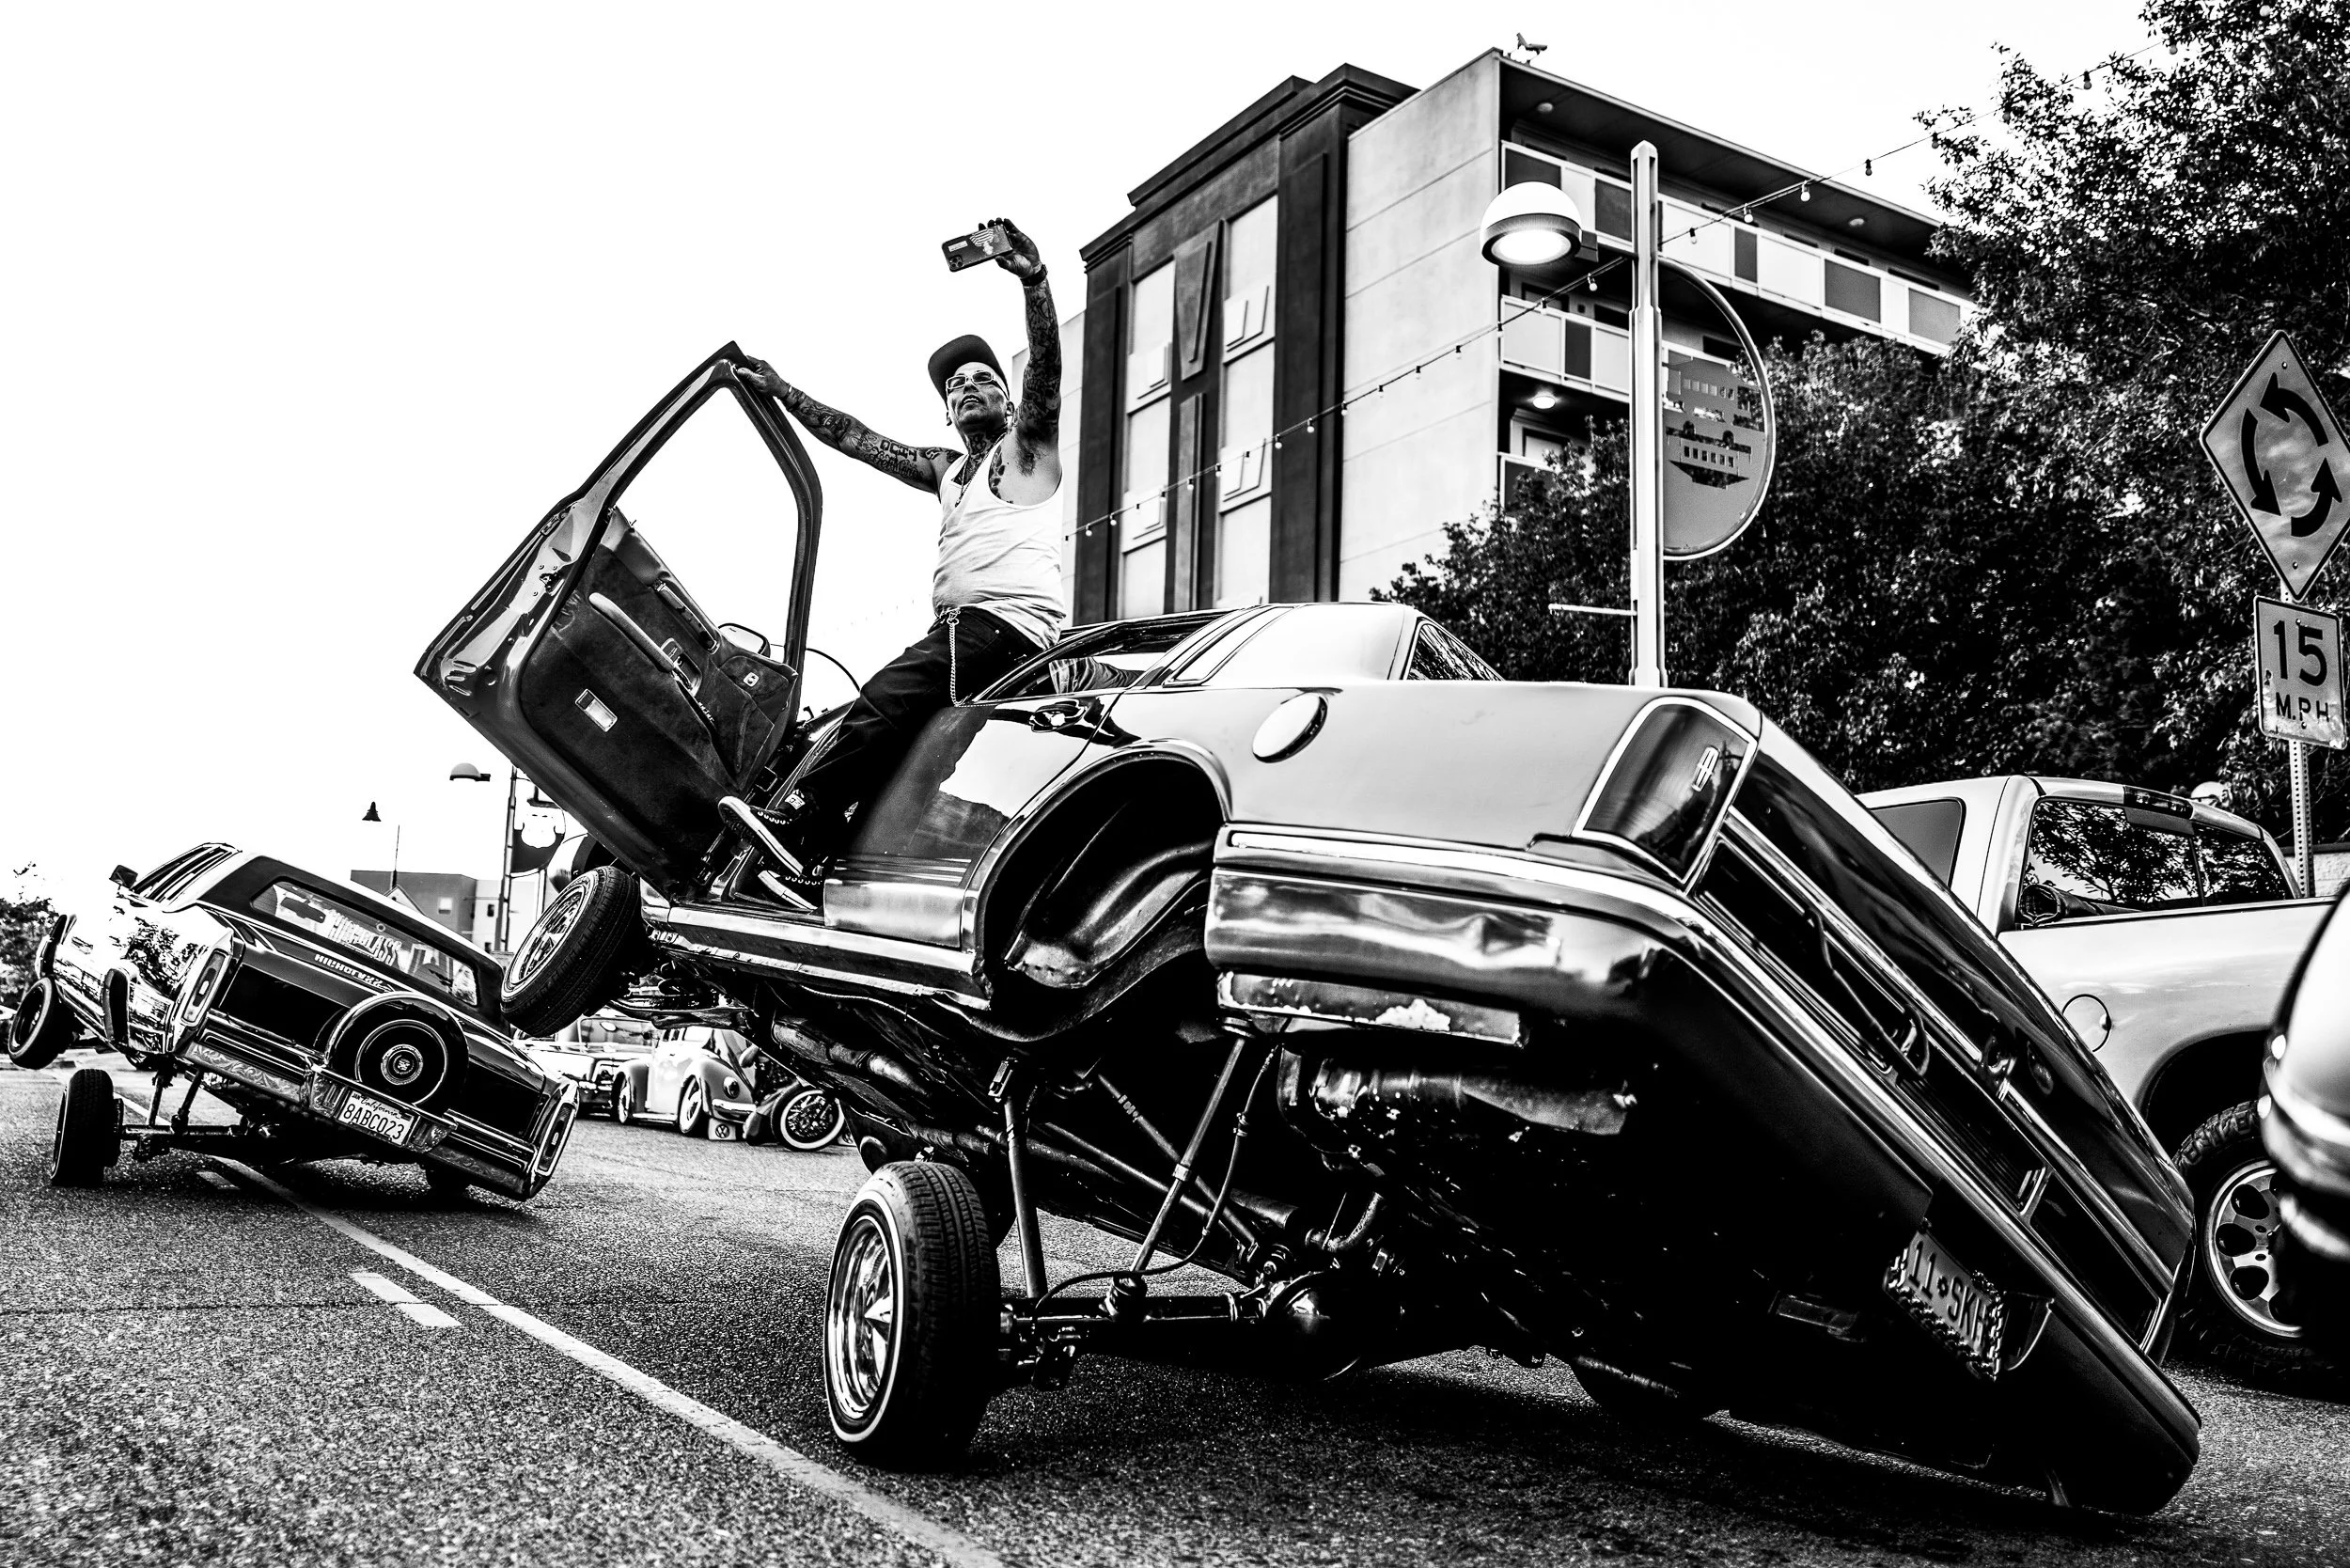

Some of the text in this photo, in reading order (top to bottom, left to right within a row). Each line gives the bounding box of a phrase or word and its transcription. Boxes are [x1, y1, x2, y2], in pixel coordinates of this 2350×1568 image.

[2273, 619, 2327, 686] 15
[343, 1104, 404, 1139] 8ABC023
[360, 1096, 401, 1119] California
